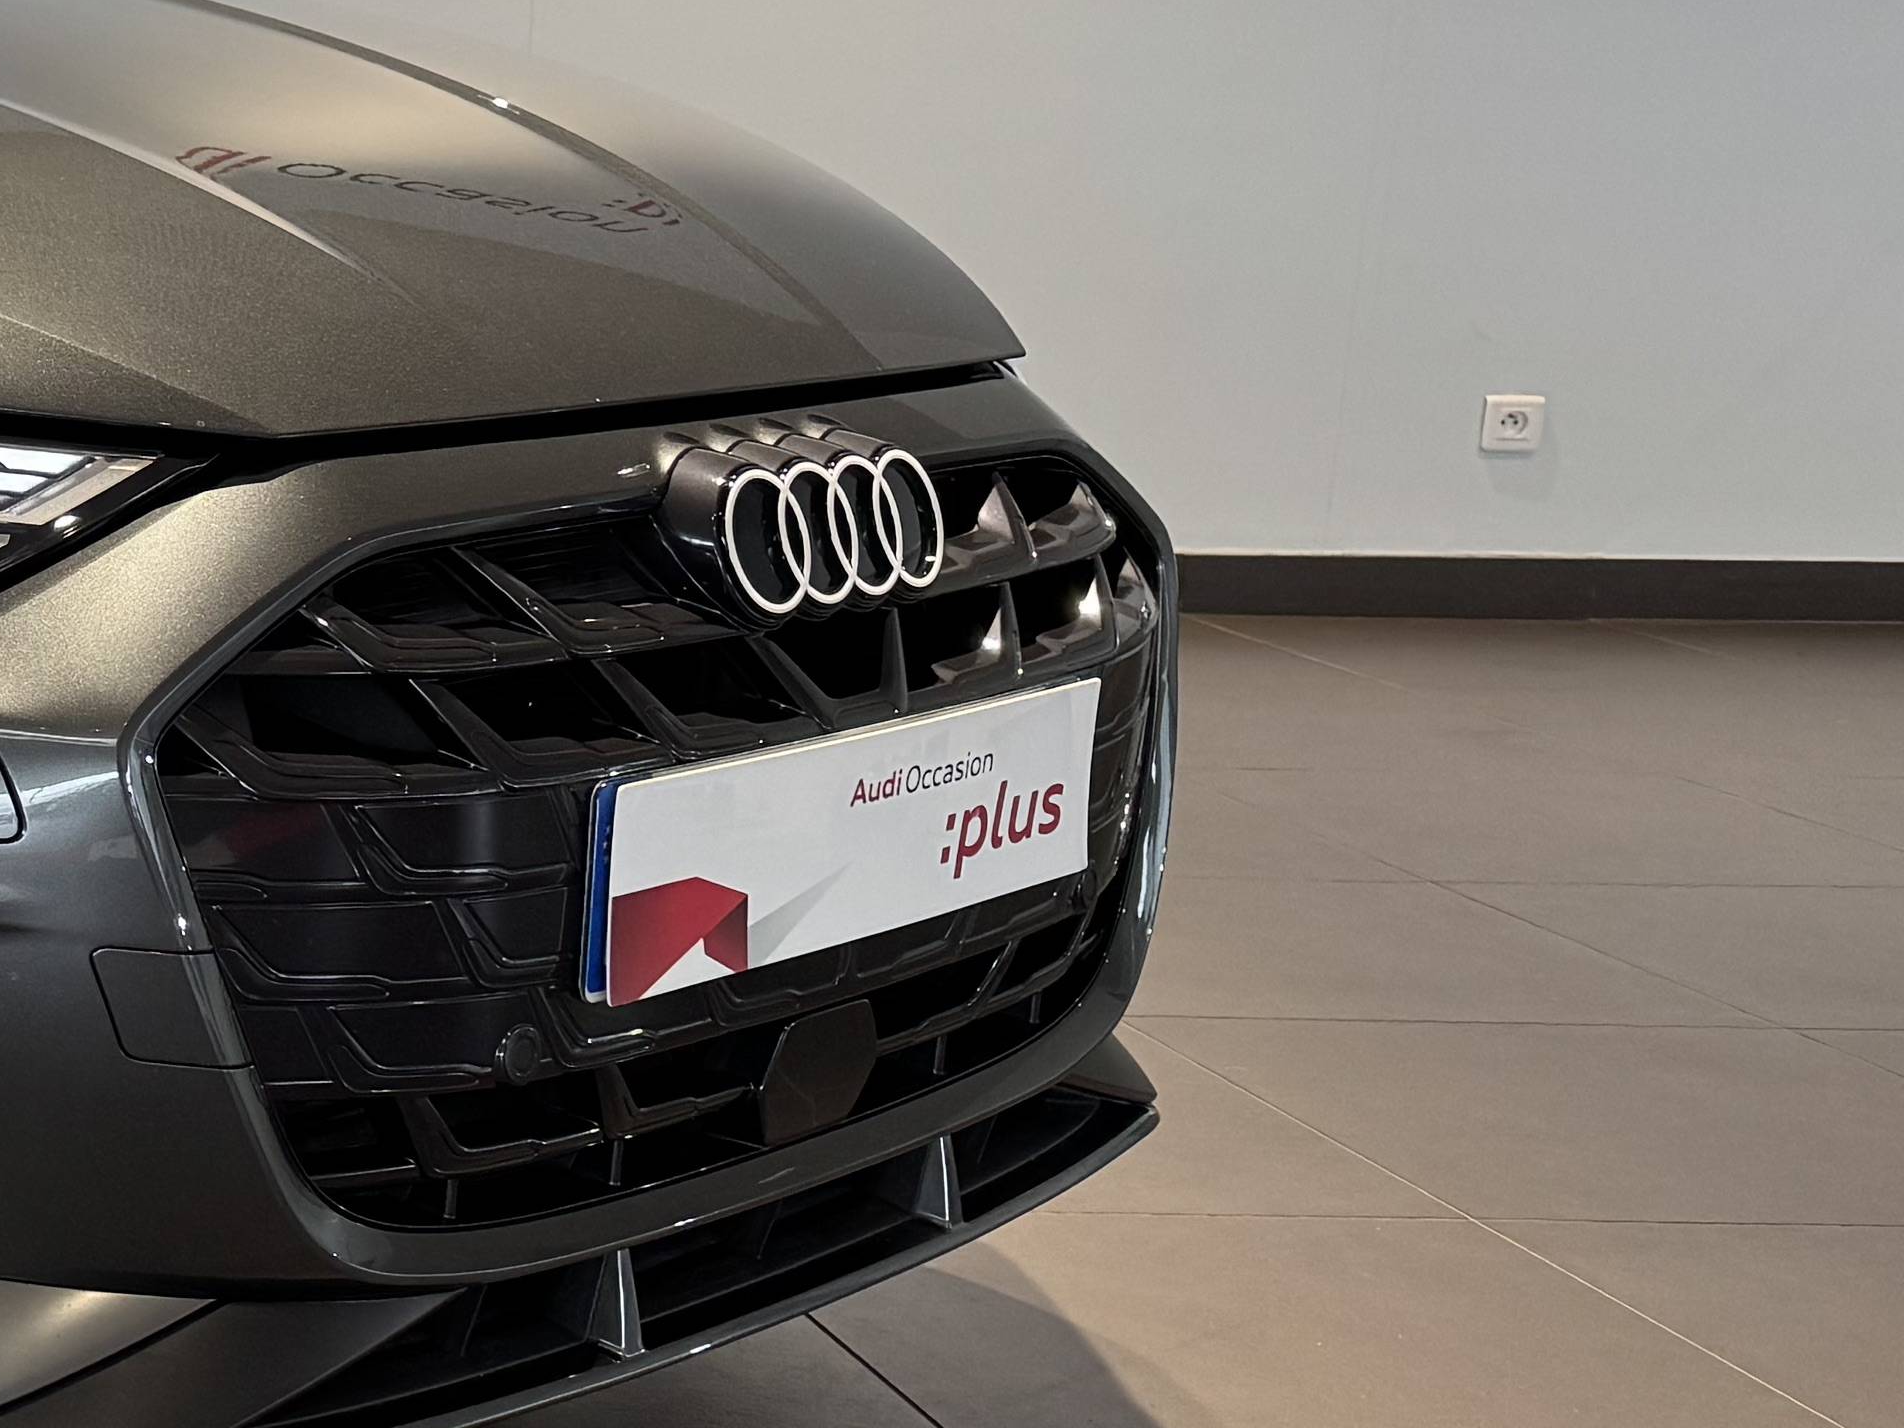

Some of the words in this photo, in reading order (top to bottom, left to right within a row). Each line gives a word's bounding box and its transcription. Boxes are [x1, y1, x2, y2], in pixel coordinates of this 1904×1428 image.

[849, 769, 903, 808] Audi
[905, 749, 994, 794] Occasion
[939, 780, 1065, 879] :plus
